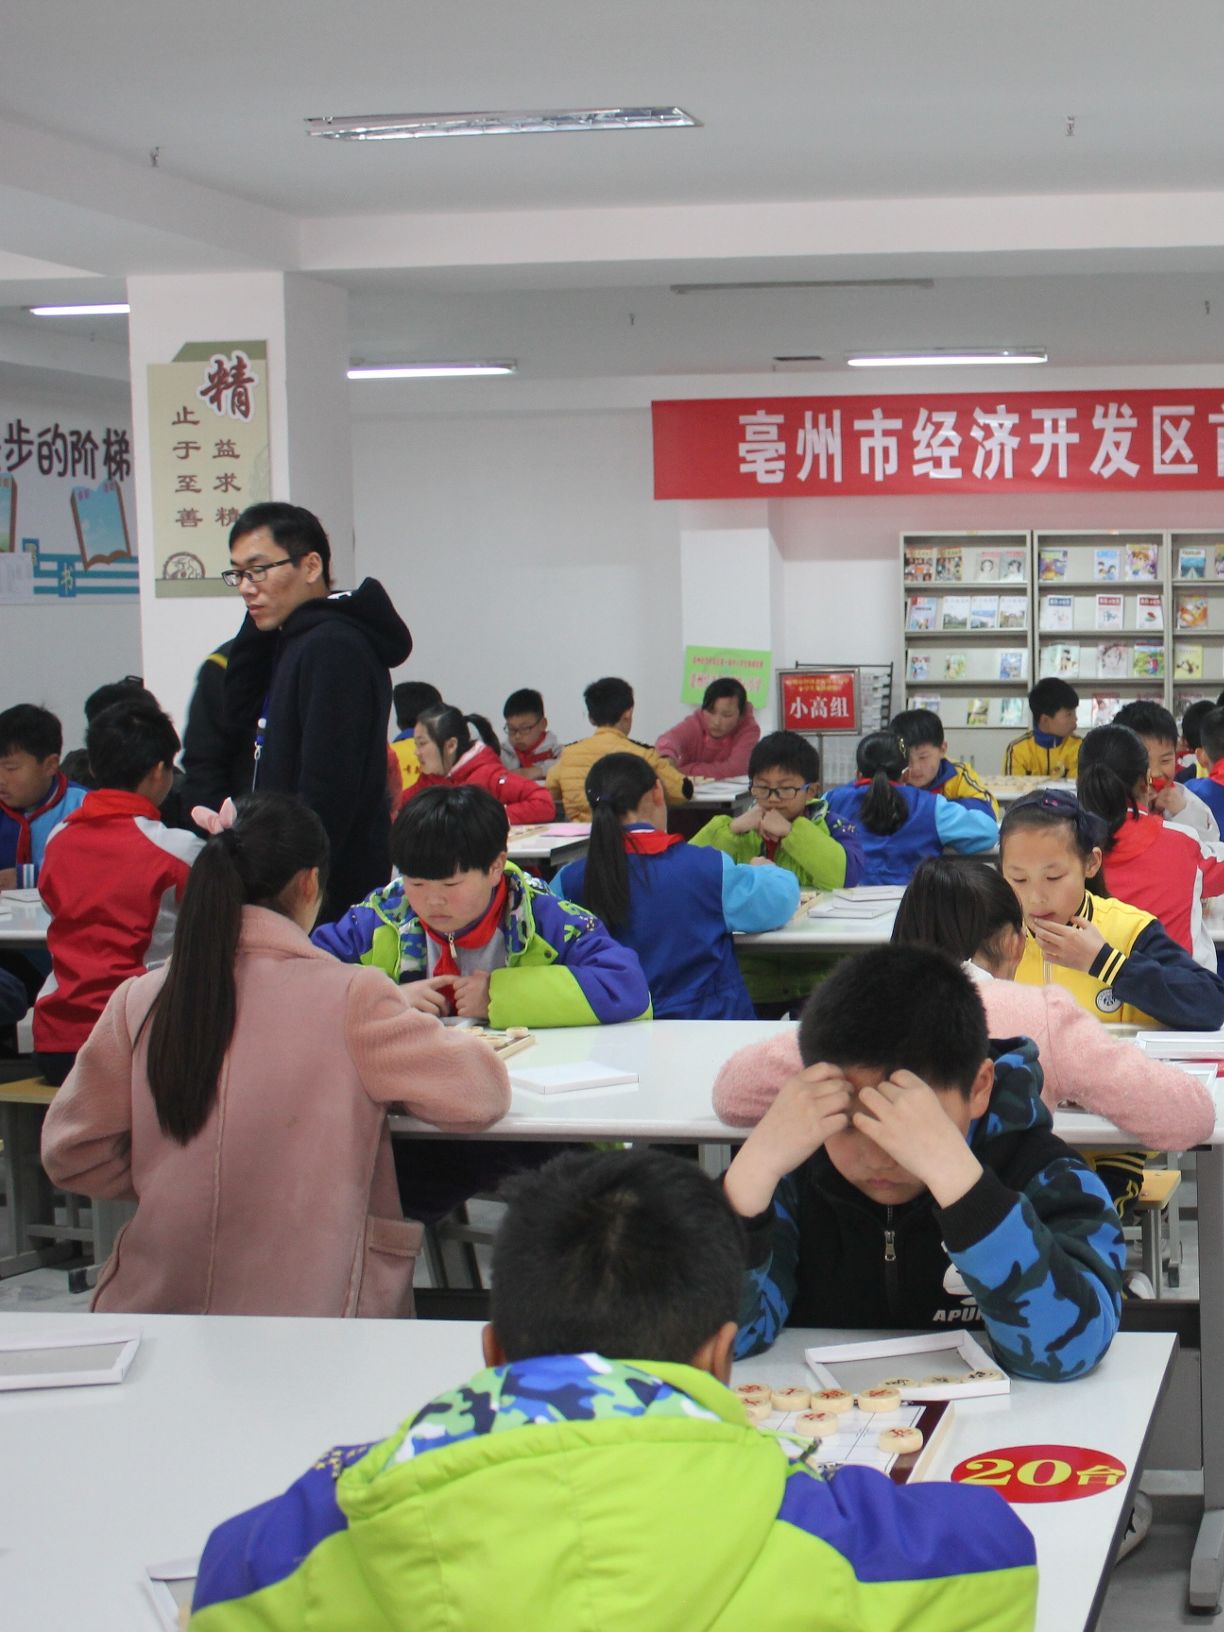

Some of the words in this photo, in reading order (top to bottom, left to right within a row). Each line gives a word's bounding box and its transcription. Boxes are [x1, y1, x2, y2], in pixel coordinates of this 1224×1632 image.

[172, 405, 203, 528] 止于至善
[790, 696, 849, 719] 小高组
[932, 1306, 981, 1322] APU
